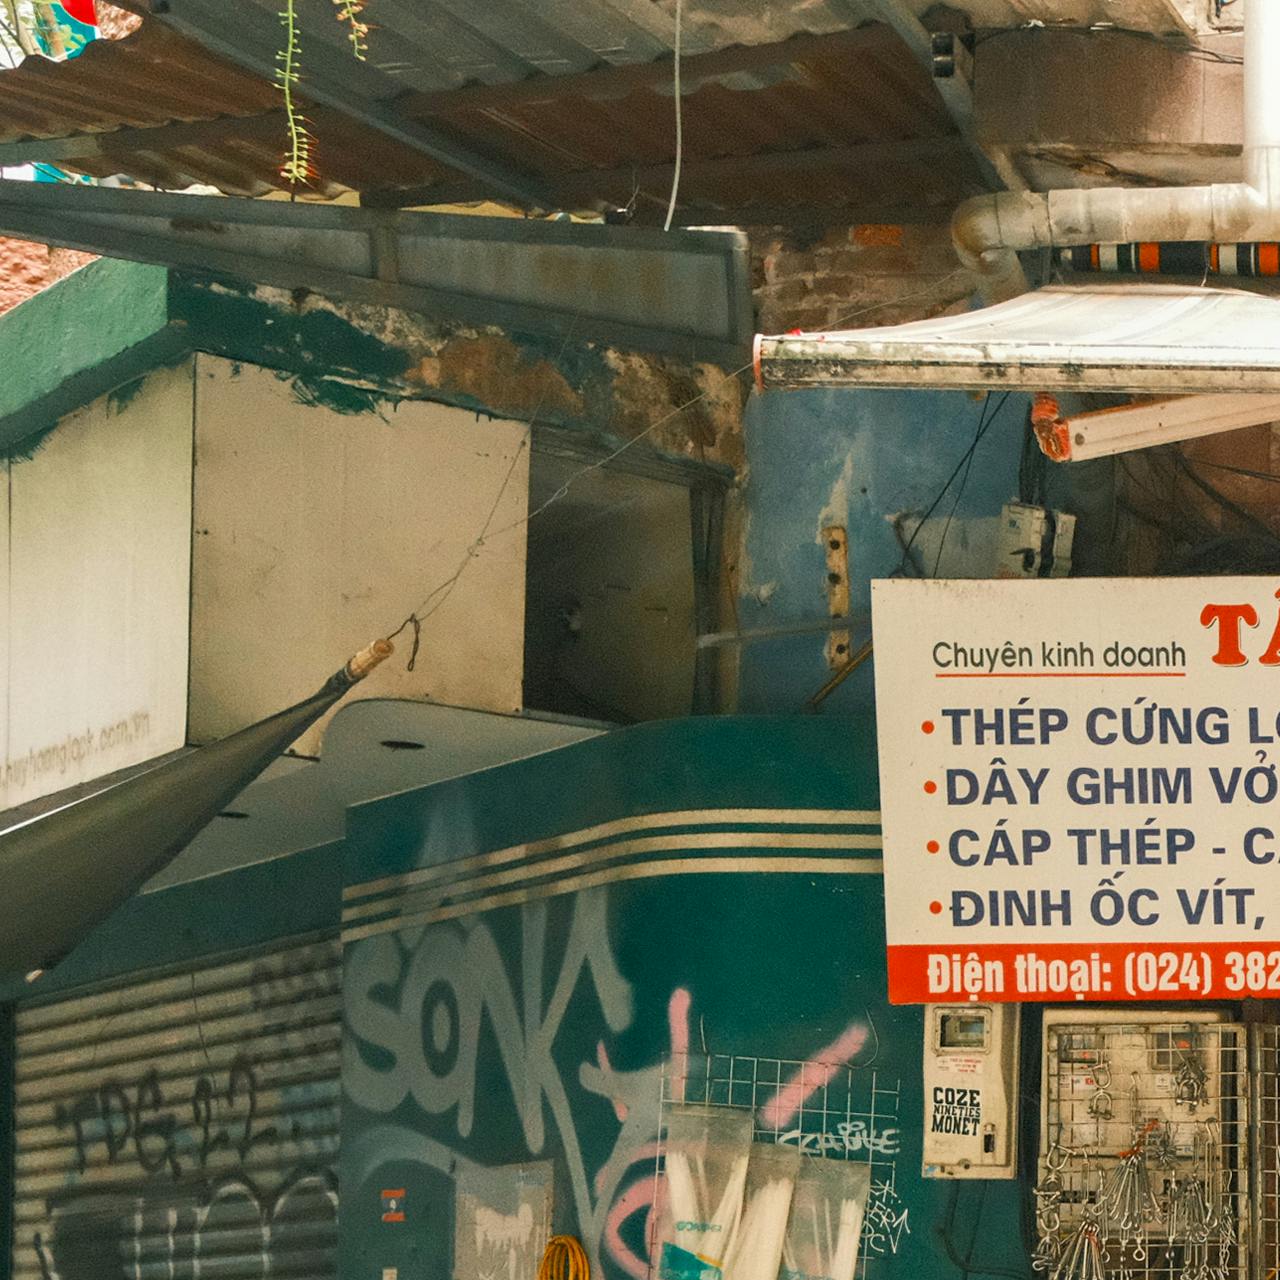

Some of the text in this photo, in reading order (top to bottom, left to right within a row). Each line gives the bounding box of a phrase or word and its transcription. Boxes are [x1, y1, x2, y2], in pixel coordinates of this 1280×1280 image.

[932, 641, 1186, 673] Chuyên kinh doanh
[942, 697, 1069, 746] THÉP
[1086, 697, 1229, 745] CỨNG
[946, 757, 1049, 805] DÂY
[1067, 767, 1192, 804] GHIM
[1210, 749, 1279, 804] VỞ
[948, 818, 1051, 867] CÁP
[1067, 818, 1196, 866] THÉP
[948, 890, 1071, 927] ĐINH
[1089, 871, 1160, 926] ỐC
[1176, 877, 1266, 931] VÍT,
[926, 953, 1005, 1000] Điện
[1014, 951, 1112, 1000] thoại:
[1124, 950, 1213, 996] (024)
[932, 1086, 981, 1108] COZE
[933, 1104, 981, 1119] NINETIES
[931, 1114, 981, 1136] MONET
